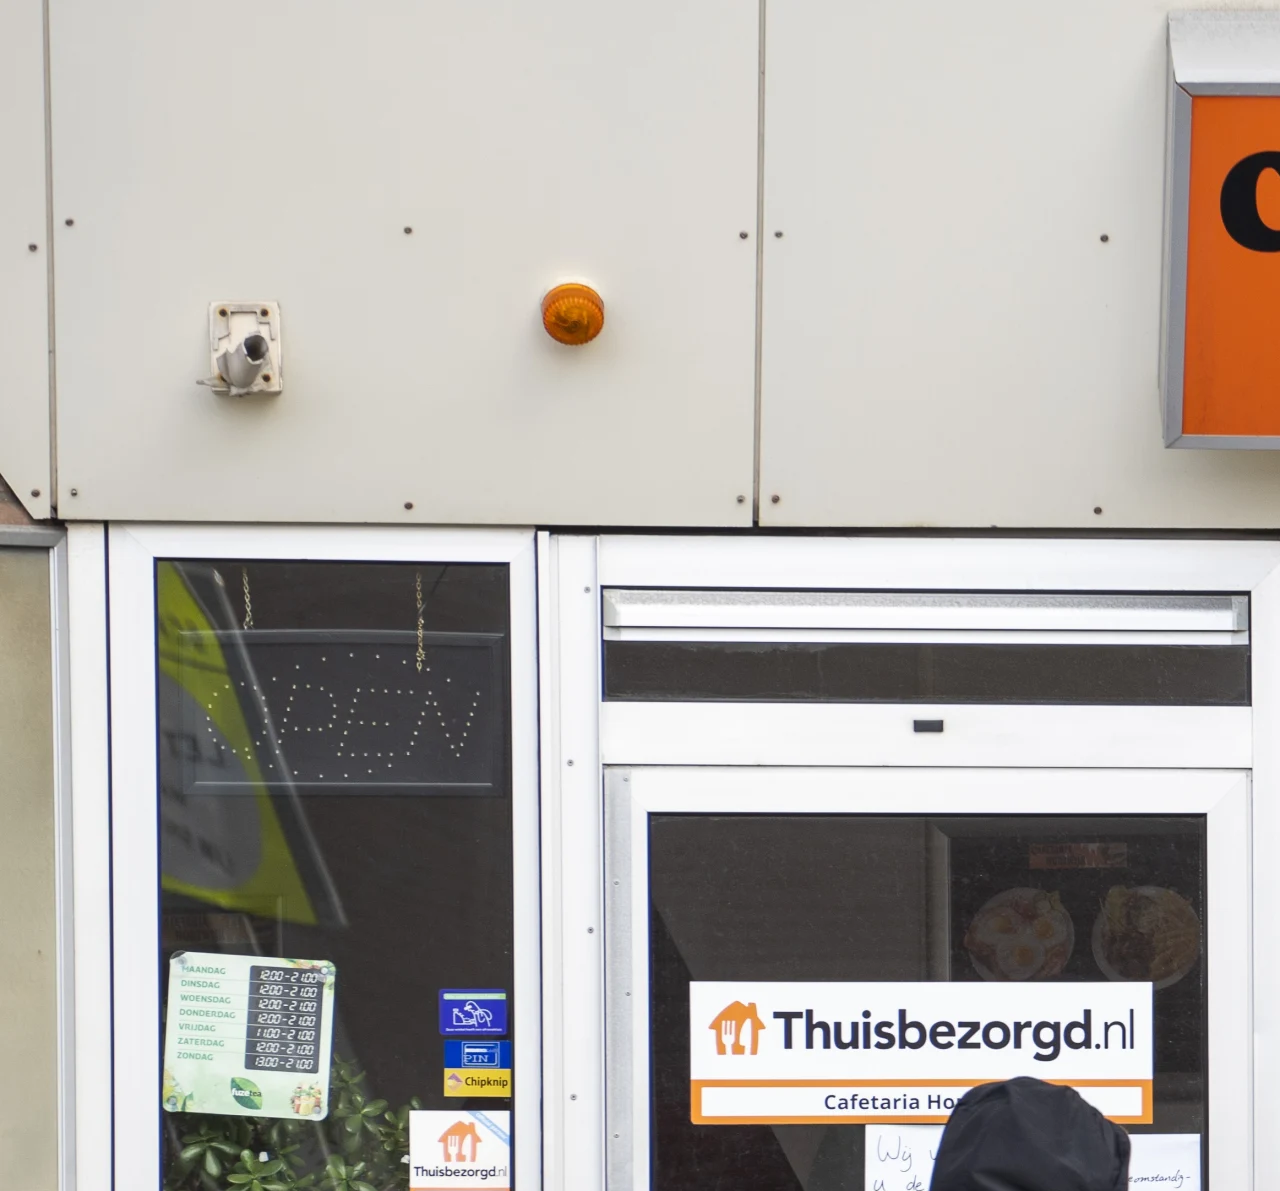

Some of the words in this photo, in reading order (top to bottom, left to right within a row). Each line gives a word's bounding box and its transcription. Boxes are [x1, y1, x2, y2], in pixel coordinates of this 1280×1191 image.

[206, 681, 480, 757] OPEN
[181, 965, 226, 975] MAANDAG
[181, 979, 220, 989] DINSDAG
[180, 994, 231, 1004] WOENSDAG
[179, 1008, 236, 1019] DONDERDAG
[178, 1023, 216, 1032] VRIJDAG
[772, 1008, 1136, 1063] Thuisbezorgd.nl
[177, 1037, 225, 1047] ZATERDAG
[177, 1052, 213, 1061] ZONDAG
[463, 1054, 489, 1063] PIN
[464, 1076, 508, 1089] Chipknip
[823, 1093, 921, 1111] Cafetaria
[877, 1135, 912, 1173] Wij
[413, 1166, 508, 1180] Thuisbezorgd.nl
[906, 1174, 925, 1191] de
